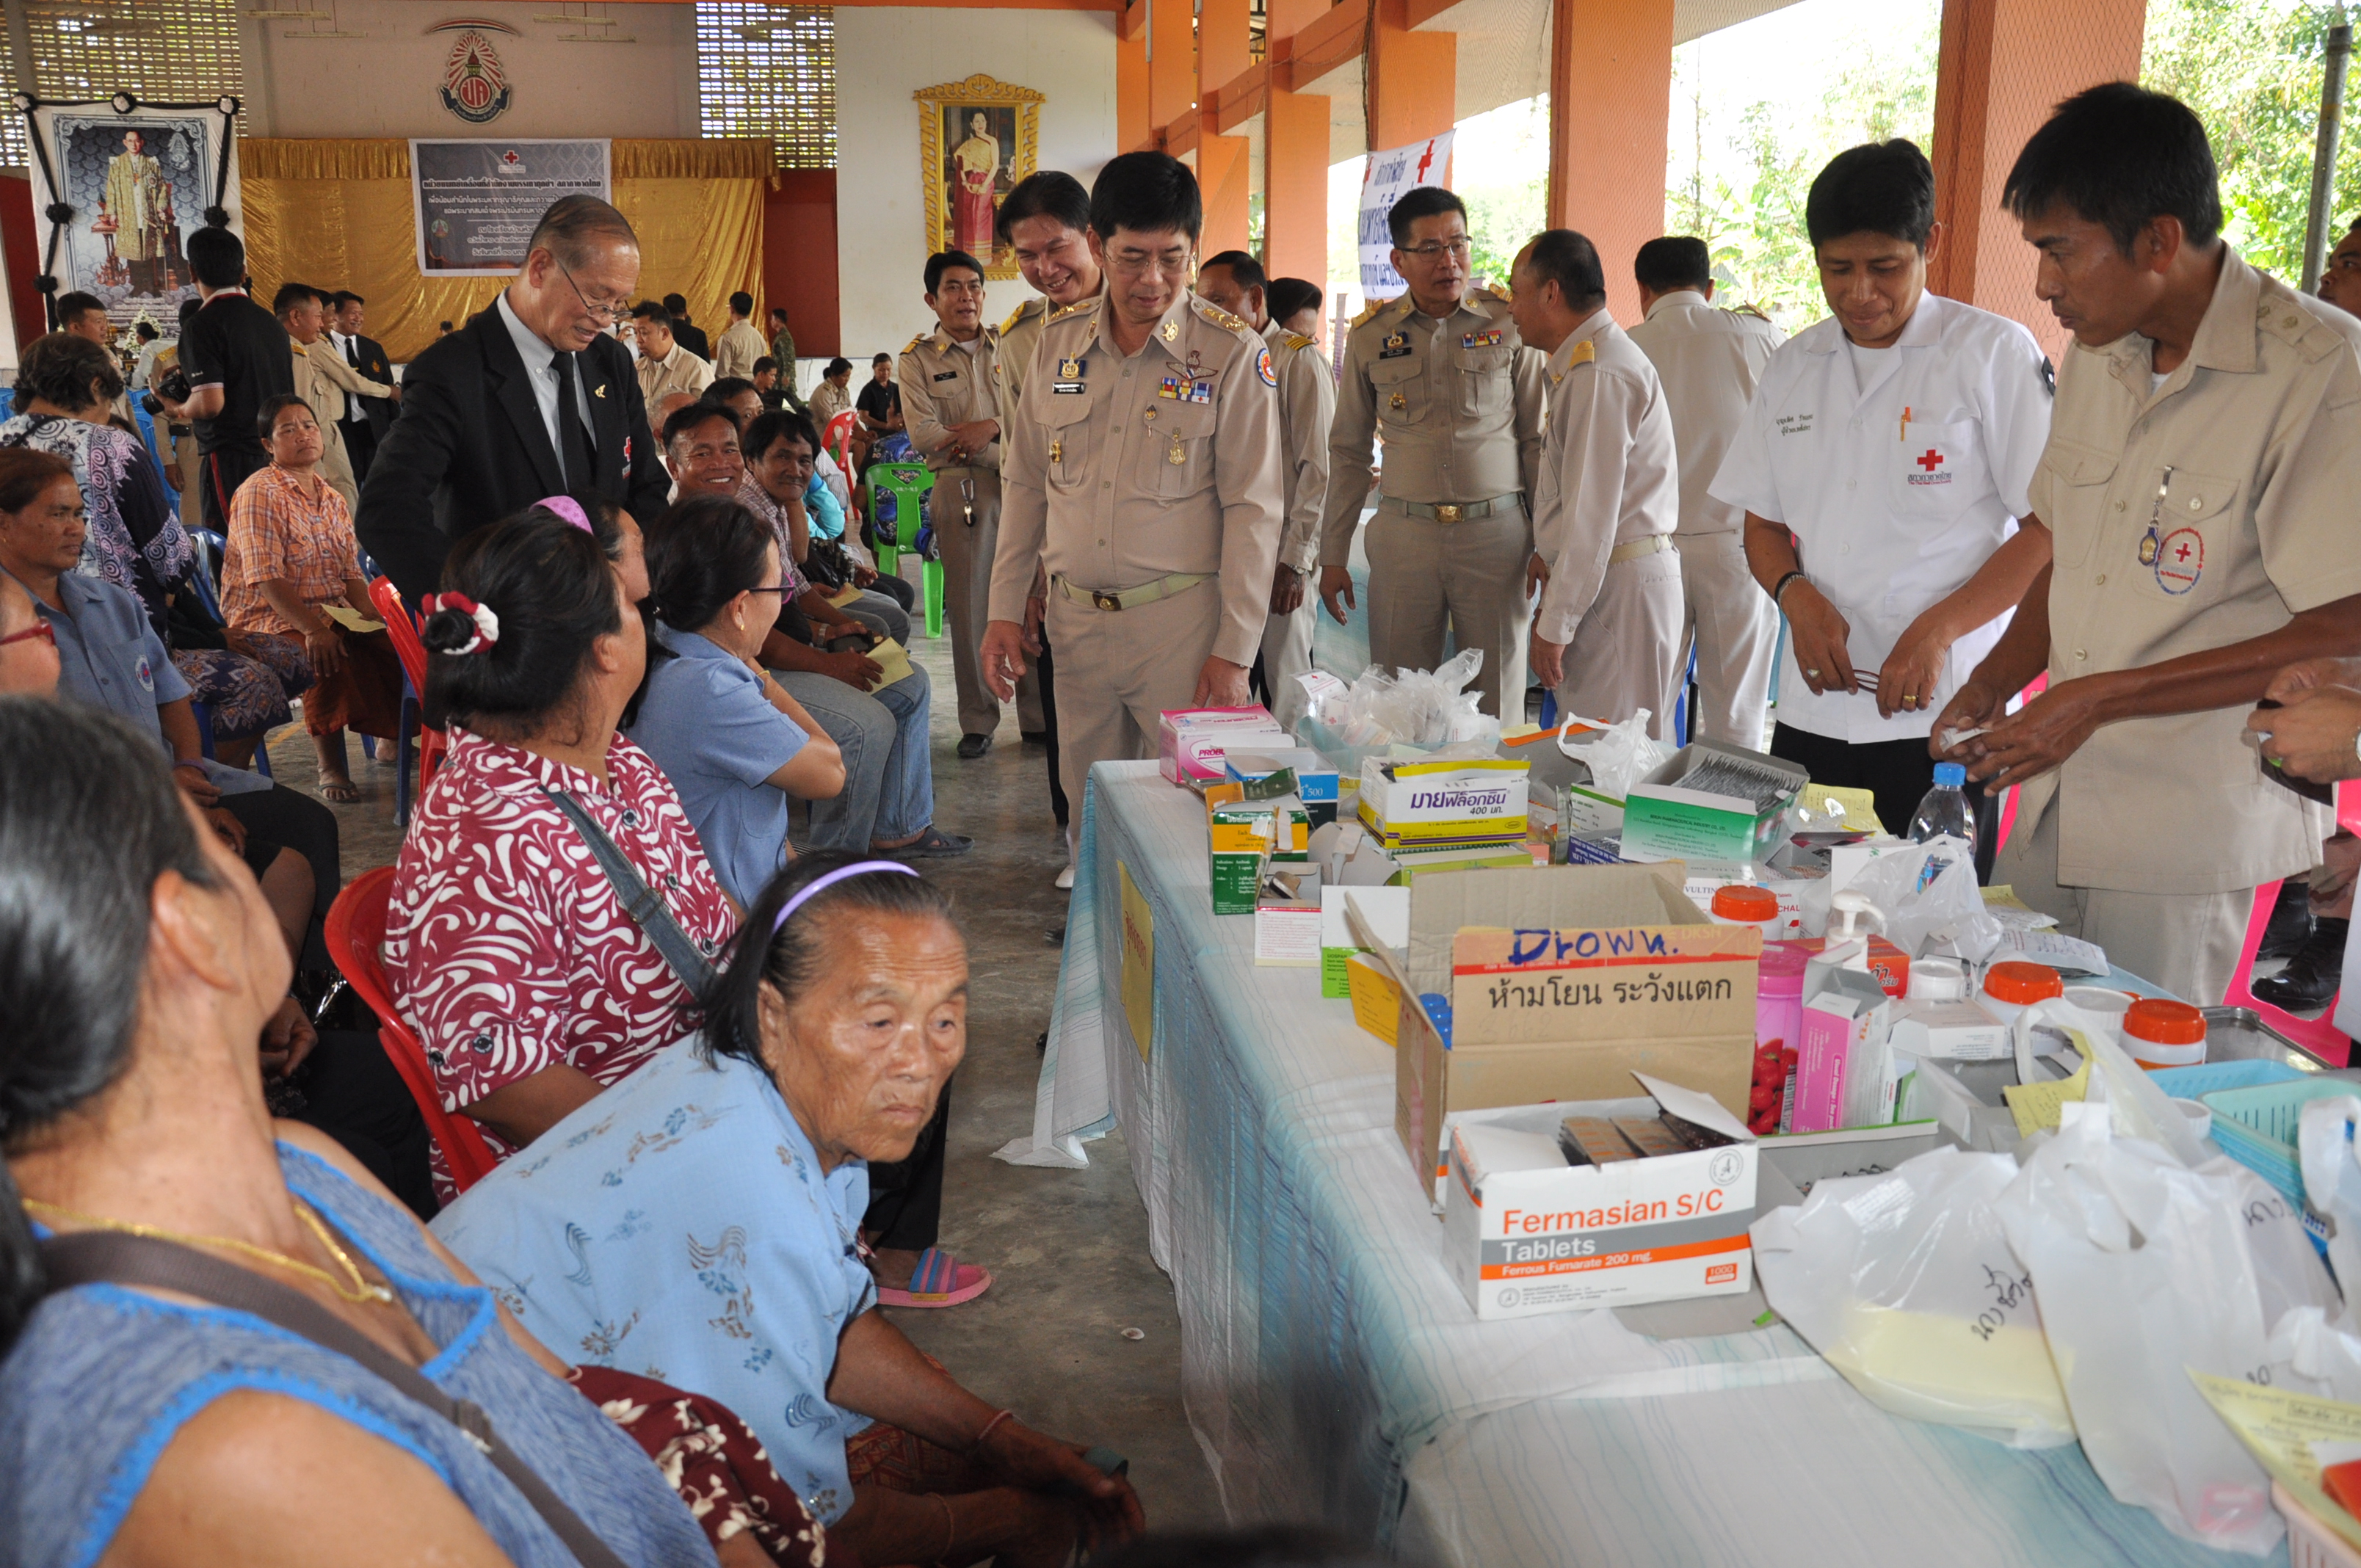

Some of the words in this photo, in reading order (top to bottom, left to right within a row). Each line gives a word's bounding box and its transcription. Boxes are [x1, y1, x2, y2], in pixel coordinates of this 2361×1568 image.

[1907, 471, 1952, 481] สภากาชาดไทย
[1308, 788, 1324, 796] 500
[1410, 788, 1507, 809] มายฟล็อกซิน
[1470, 807, 1487, 816] 400
[1490, 806, 1504, 815] มก.
[1662, 816, 1693, 826] PHARMACEUTICAL
[1694, 821, 1711, 829] INDUSTRY
[1681, 926, 1722, 940] DKSH
[1488, 976, 1602, 1009] ห้ามโยน
[1613, 973, 1732, 1003] ระวังแตก
[1503, 1199, 1667, 1235] Fermasian
[1676, 1188, 1724, 1216] S/C
[1502, 1237, 1596, 1263] Tablets
[1502, 1264, 1545, 1277] Ferrous
[1548, 1258, 1602, 1274] Fumarate
[1606, 1252, 1629, 1266] 200
[1631, 1251, 1653, 1265] mg.
[1711, 1264, 1733, 1276] 1000
